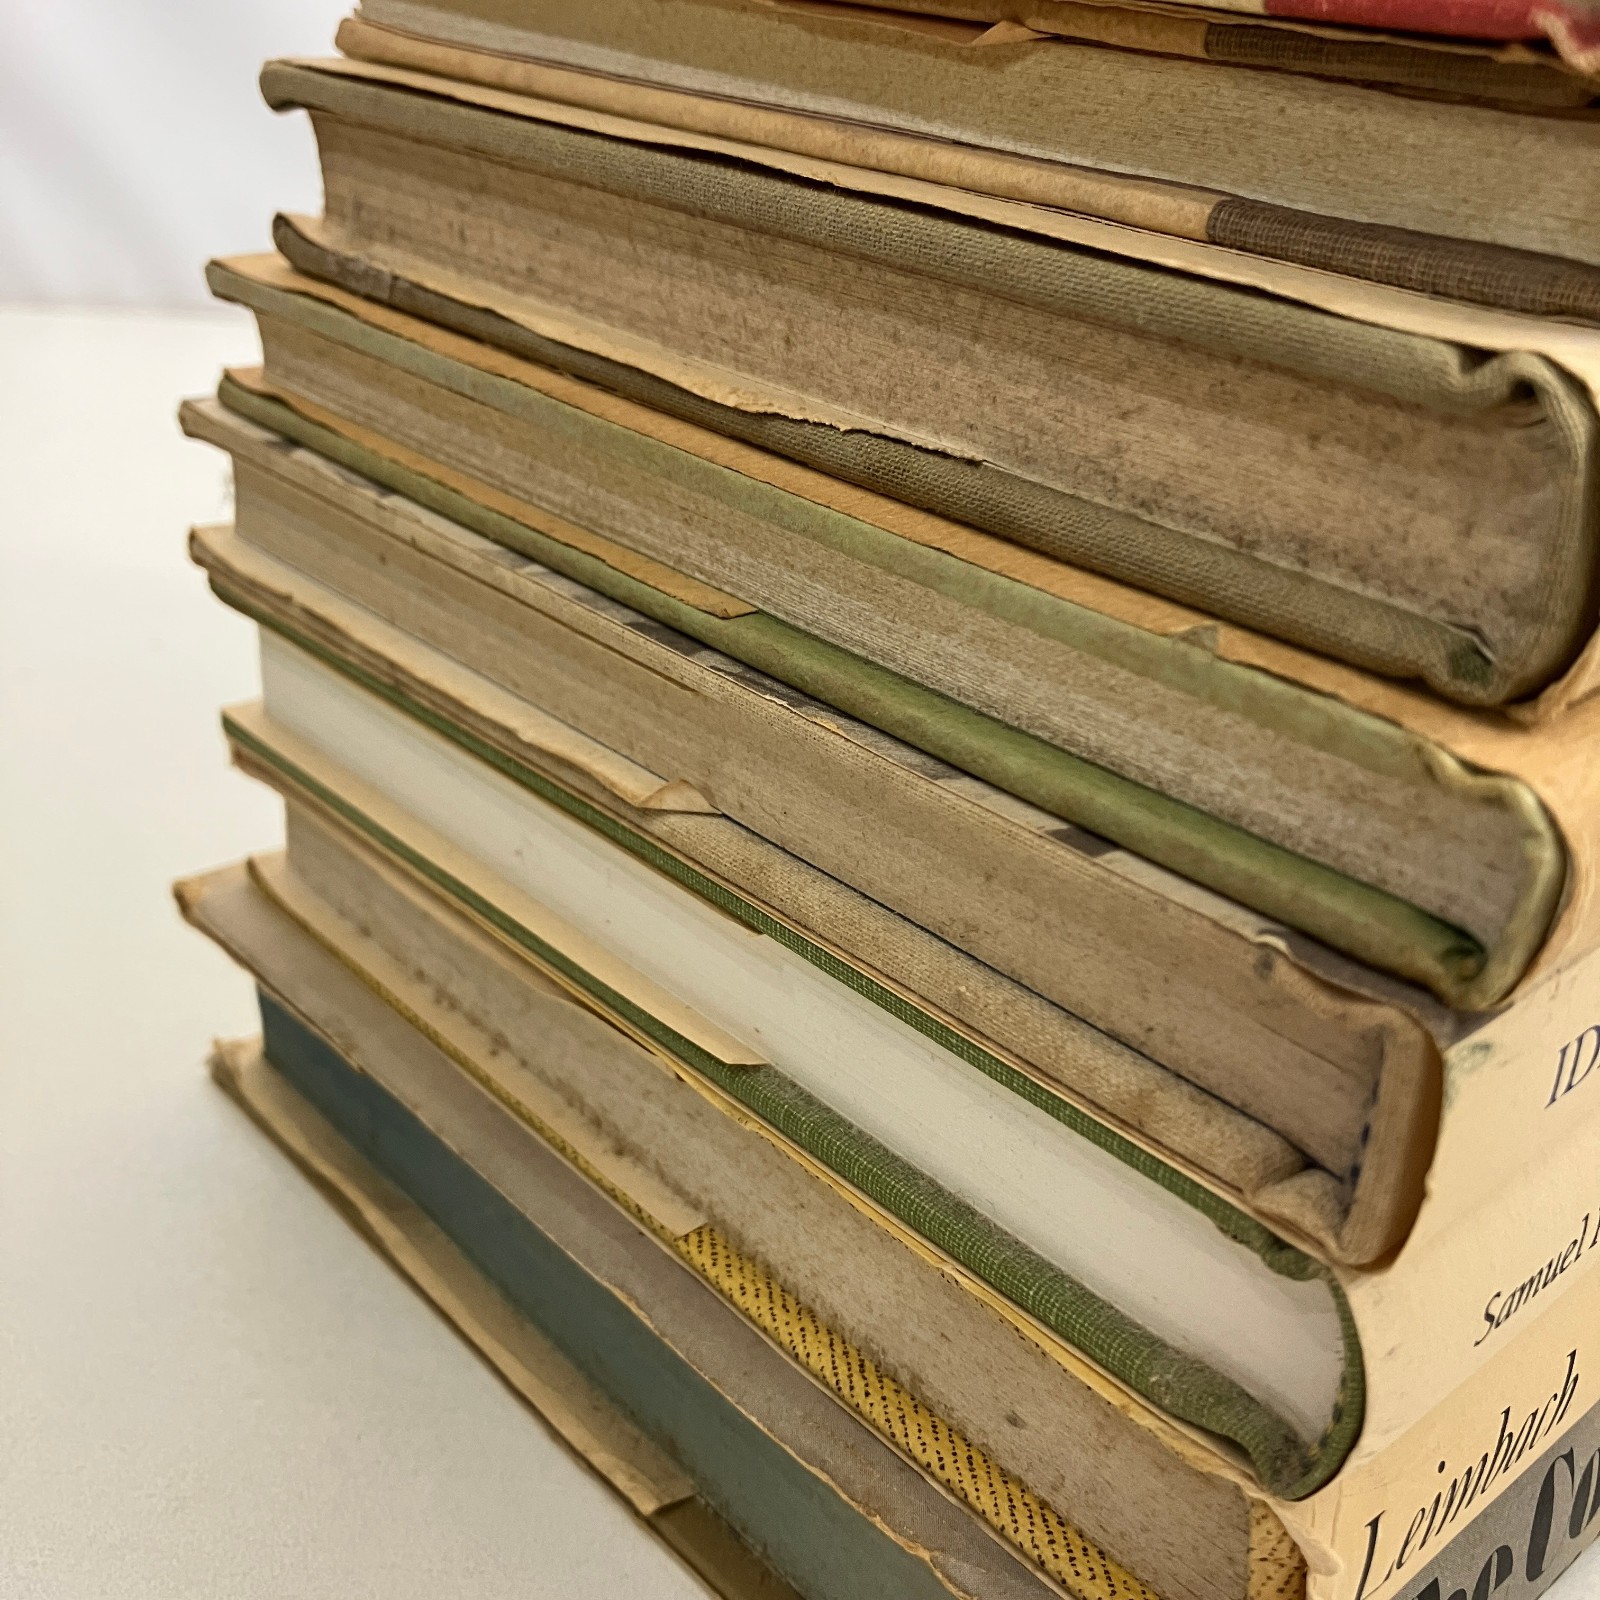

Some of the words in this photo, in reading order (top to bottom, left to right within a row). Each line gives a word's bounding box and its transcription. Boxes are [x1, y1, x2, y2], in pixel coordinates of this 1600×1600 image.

[1544, 1024, 1600, 1110] ID
[1473, 1212, 1590, 1347] Samuel
[1354, 1348, 1579, 1600] Leimbach
